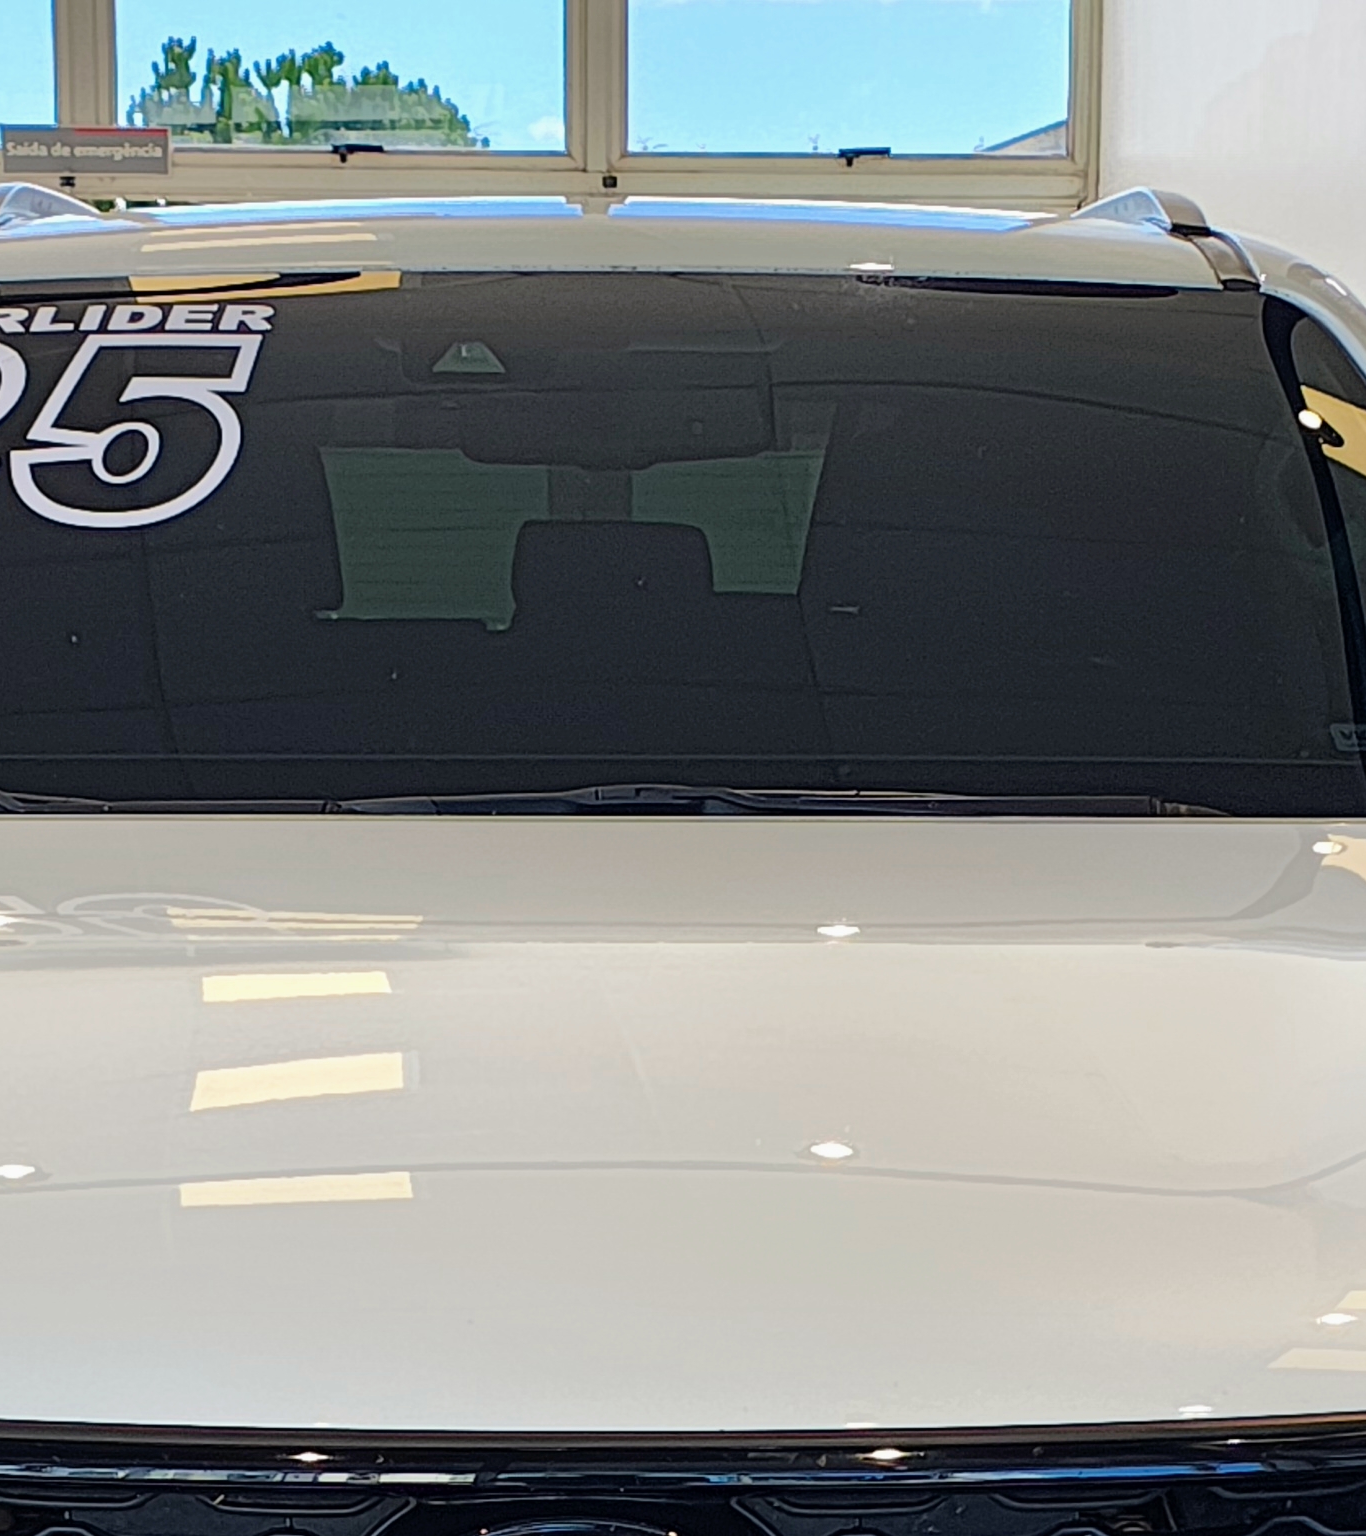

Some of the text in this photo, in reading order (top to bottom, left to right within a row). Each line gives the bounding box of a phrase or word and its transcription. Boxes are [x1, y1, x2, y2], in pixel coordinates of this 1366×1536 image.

[6, 141, 163, 161] Saída de emergência
